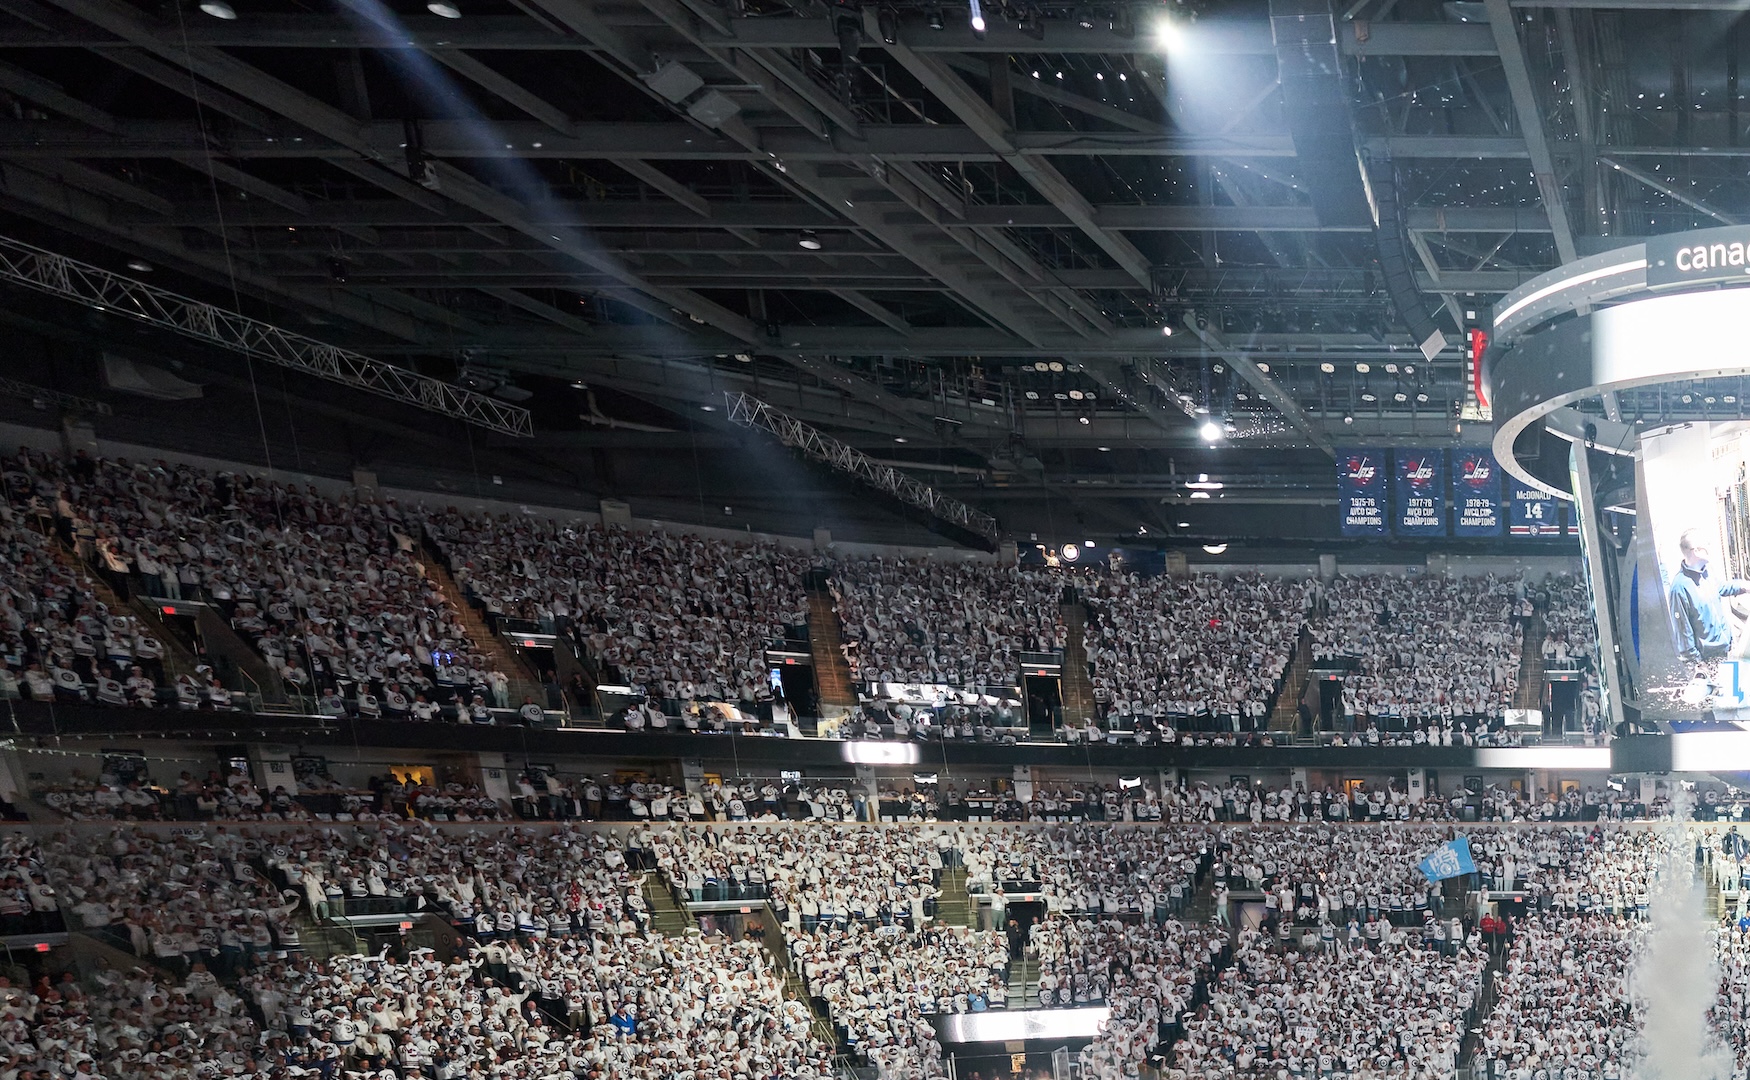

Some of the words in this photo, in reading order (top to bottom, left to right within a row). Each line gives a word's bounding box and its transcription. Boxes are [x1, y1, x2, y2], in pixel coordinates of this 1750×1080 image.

[1525, 503, 1543, 519] 14
[1346, 517, 1382, 526] CHAMPIONS
[1403, 517, 1439, 526] CHAMPIONS
[1460, 517, 1496, 526] CHAMPIONS
